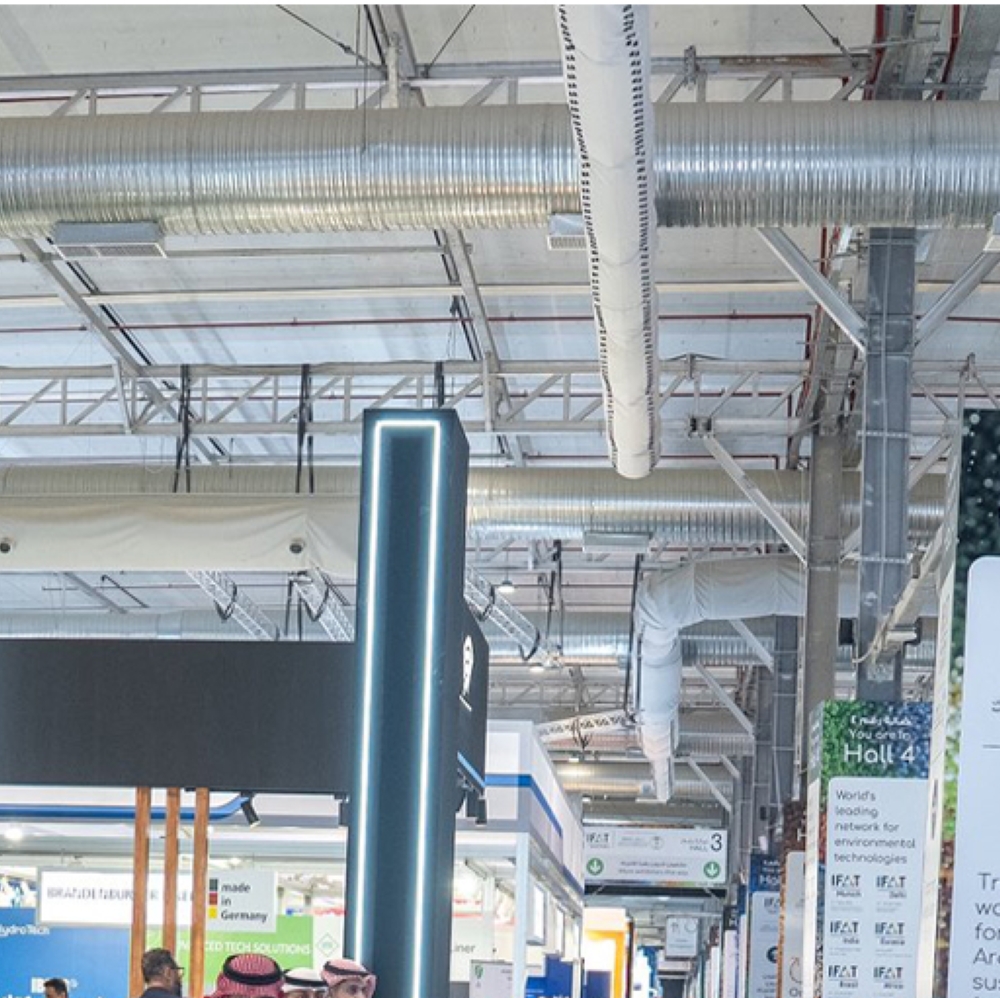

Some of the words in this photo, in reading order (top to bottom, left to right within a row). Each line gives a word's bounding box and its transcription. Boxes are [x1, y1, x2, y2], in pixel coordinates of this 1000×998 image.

[849, 729, 872, 740] You
[875, 731, 896, 740] are
[899, 729, 911, 740] in
[844, 743, 893, 764] Hall
[901, 744, 915, 764] 4
[836, 790, 876, 801] World's
[835, 805, 879, 819] leading
[834, 823, 879, 832] network
[883, 822, 900, 832] for
[710, 833, 722, 852] 3
[834, 838, 916, 849] environmental
[834, 853, 907, 865] technologies
[221, 883, 251, 893] made
[221, 896, 231, 905] in
[220, 910, 268, 923] Germany
[224, 942, 251, 952] TECH
[254, 943, 311, 954] SOLUTIONS
